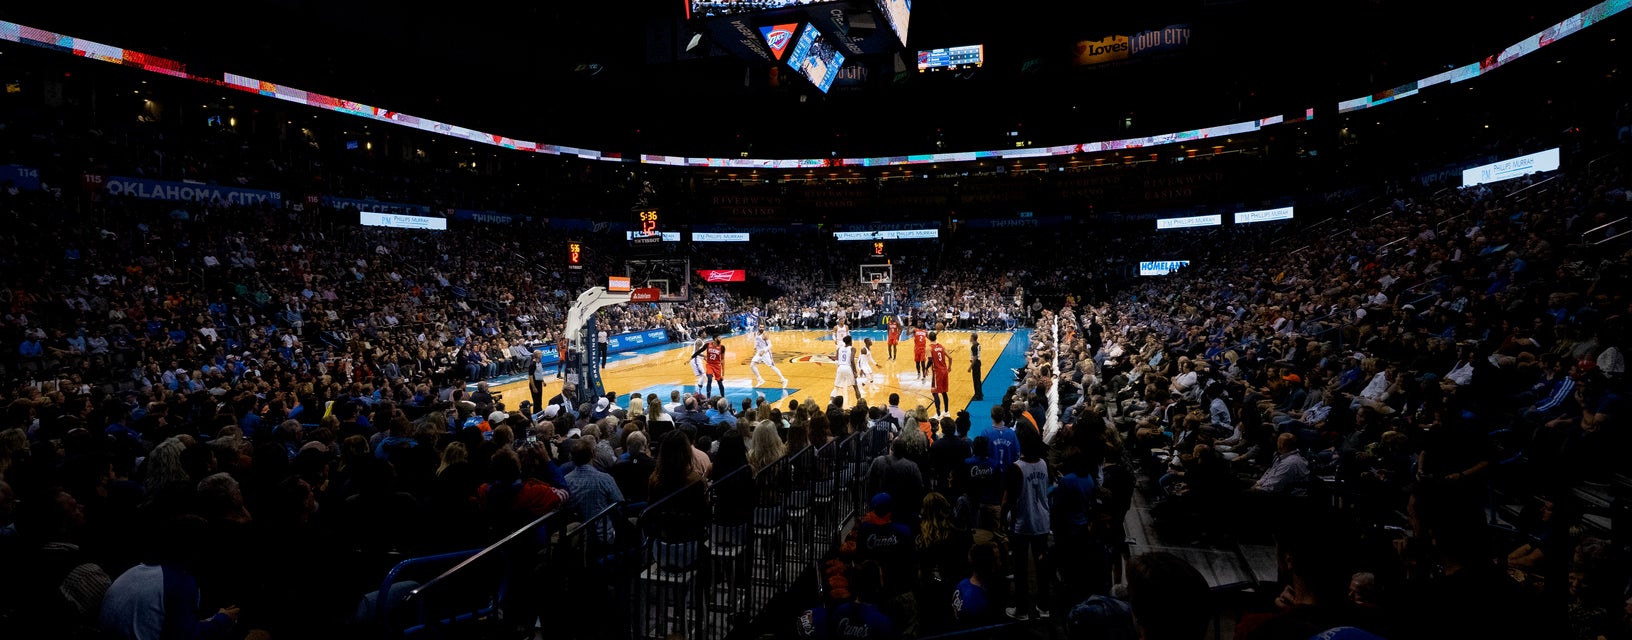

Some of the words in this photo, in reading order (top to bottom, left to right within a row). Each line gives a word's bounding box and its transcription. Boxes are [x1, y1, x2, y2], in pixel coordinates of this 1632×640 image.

[1131, 31, 1160, 55] LOUD
[1164, 28, 1191, 46] CITY
[17, 168, 38, 178] 114
[85, 174, 103, 184] 115
[106, 180, 221, 202] OKLAHOMA
[228, 191, 267, 206] CITY
[640, 211, 658, 221] 5:36
[643, 221, 656, 236] 12
[937, 352, 943, 362] 3
